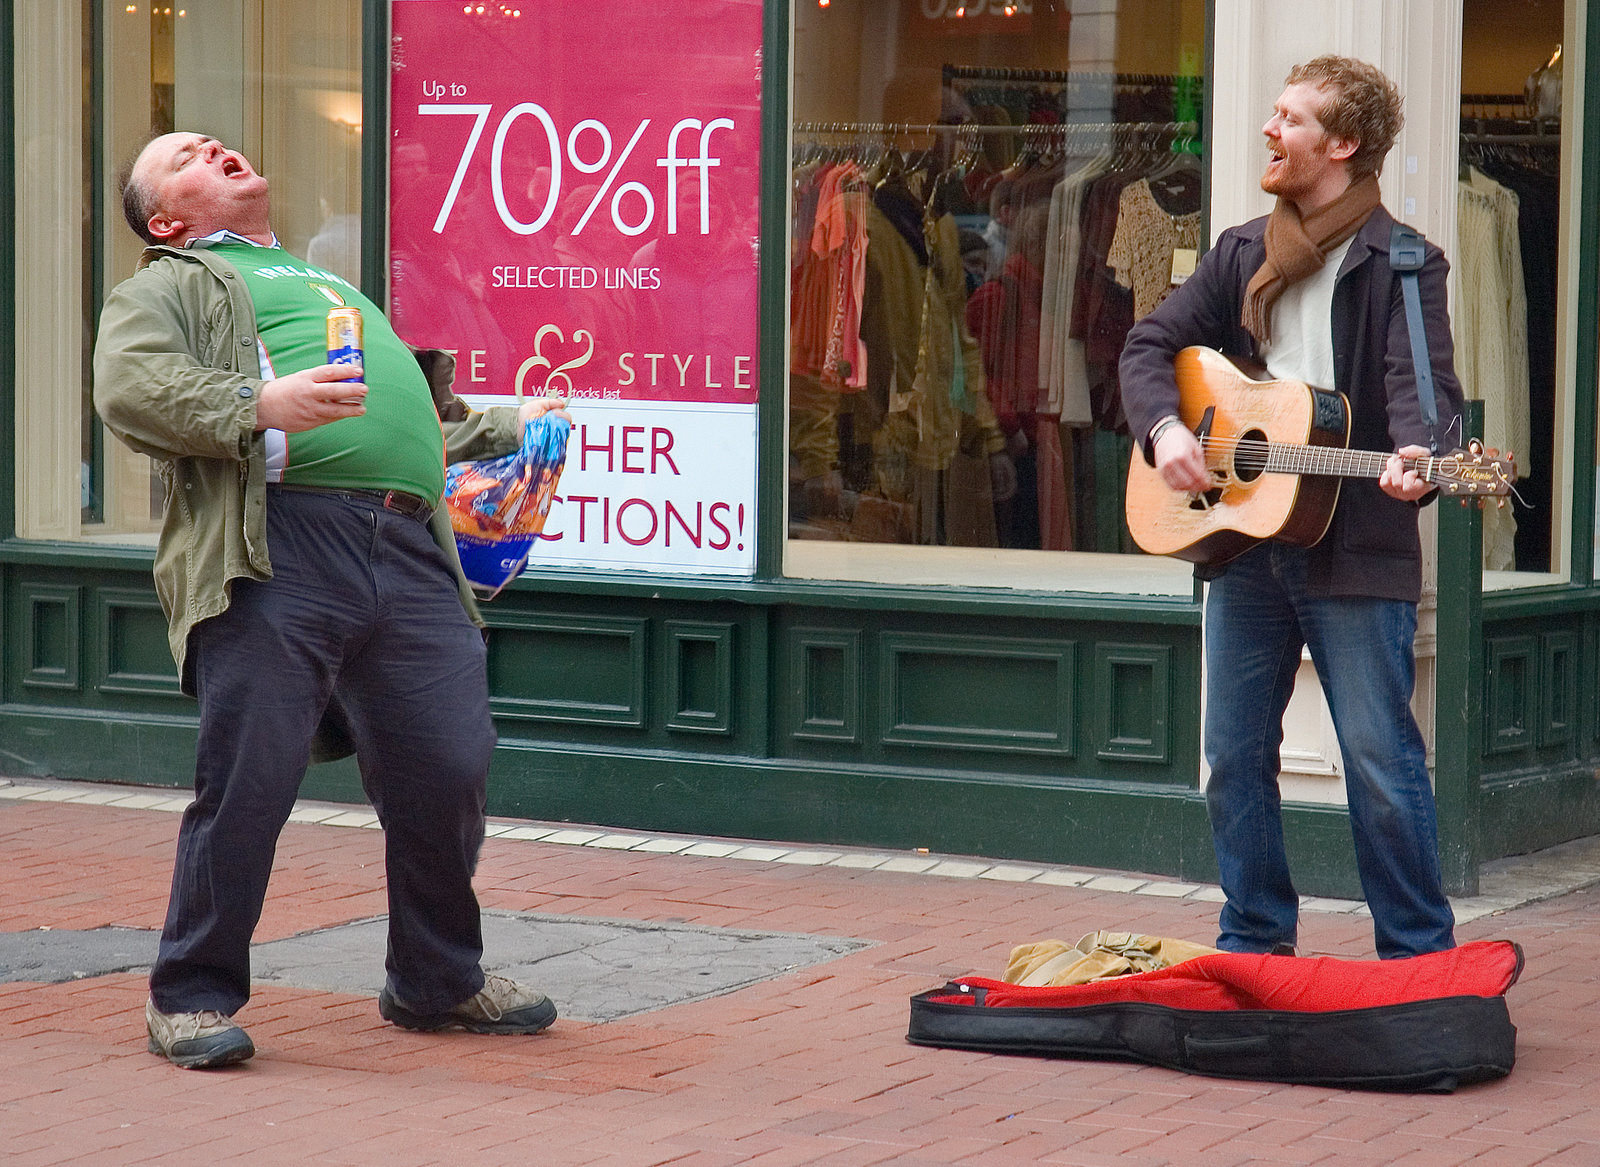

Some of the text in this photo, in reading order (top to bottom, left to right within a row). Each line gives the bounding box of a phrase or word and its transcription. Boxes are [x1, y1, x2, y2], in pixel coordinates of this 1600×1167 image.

[422, 80, 467, 101] Up to
[418, 101, 735, 236] 70%ff
[491, 265, 661, 290] SELECTED LINES
[617, 352, 751, 389] STYLE
[531, 384, 565, 398] Wile
[602, 386, 621, 400] last
[570, 422, 681, 475] HER
